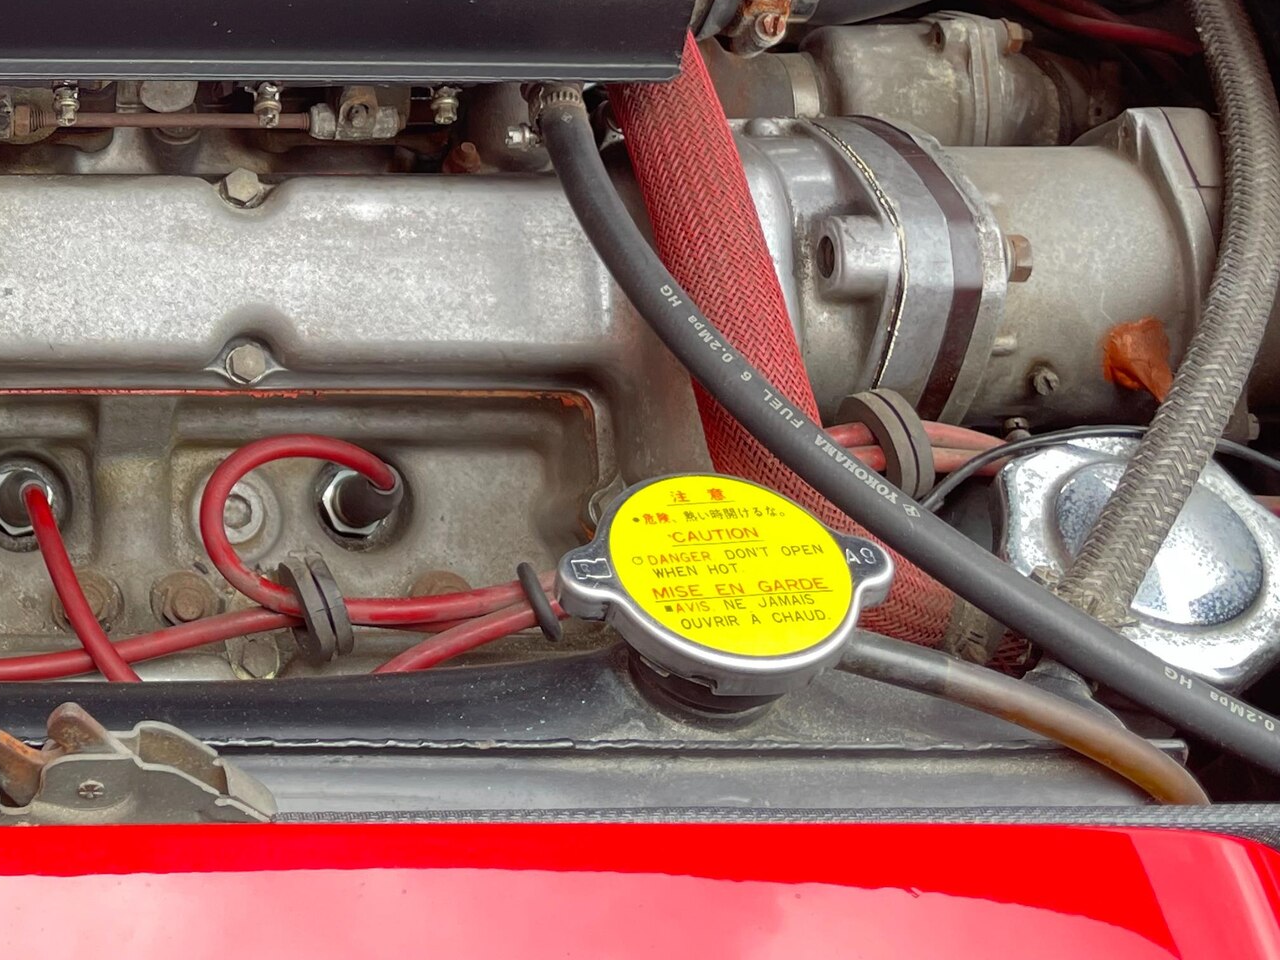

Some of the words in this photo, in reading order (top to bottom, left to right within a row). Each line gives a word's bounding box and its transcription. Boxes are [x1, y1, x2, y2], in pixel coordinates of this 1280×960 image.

[659, 284, 682, 308] HG
[687, 314, 734, 364] 0.2Mpa
[740, 371, 753, 382] 6
[763, 388, 805, 429] FUEL
[814, 434, 899, 505] YOKOHAMA
[671, 527, 760, 544] CAUTION
[647, 550, 712, 566] DANGER
[724, 546, 769, 560] DON'T
[780, 544, 825, 557] OPEN
[652, 565, 699, 579] WHEN
[652, 584, 704, 600] MISE
[714, 582, 746, 596] EN
[757, 577, 829, 593] GARDE
[723, 598, 747, 611] NE
[758, 593, 816, 609] JAMAIS
[680, 614, 741, 630] OUVRIR
[771, 608, 832, 623] CHAUD.
[1163, 665, 1193, 690] HG
[1209, 690, 1276, 732] 0.2Mpa
